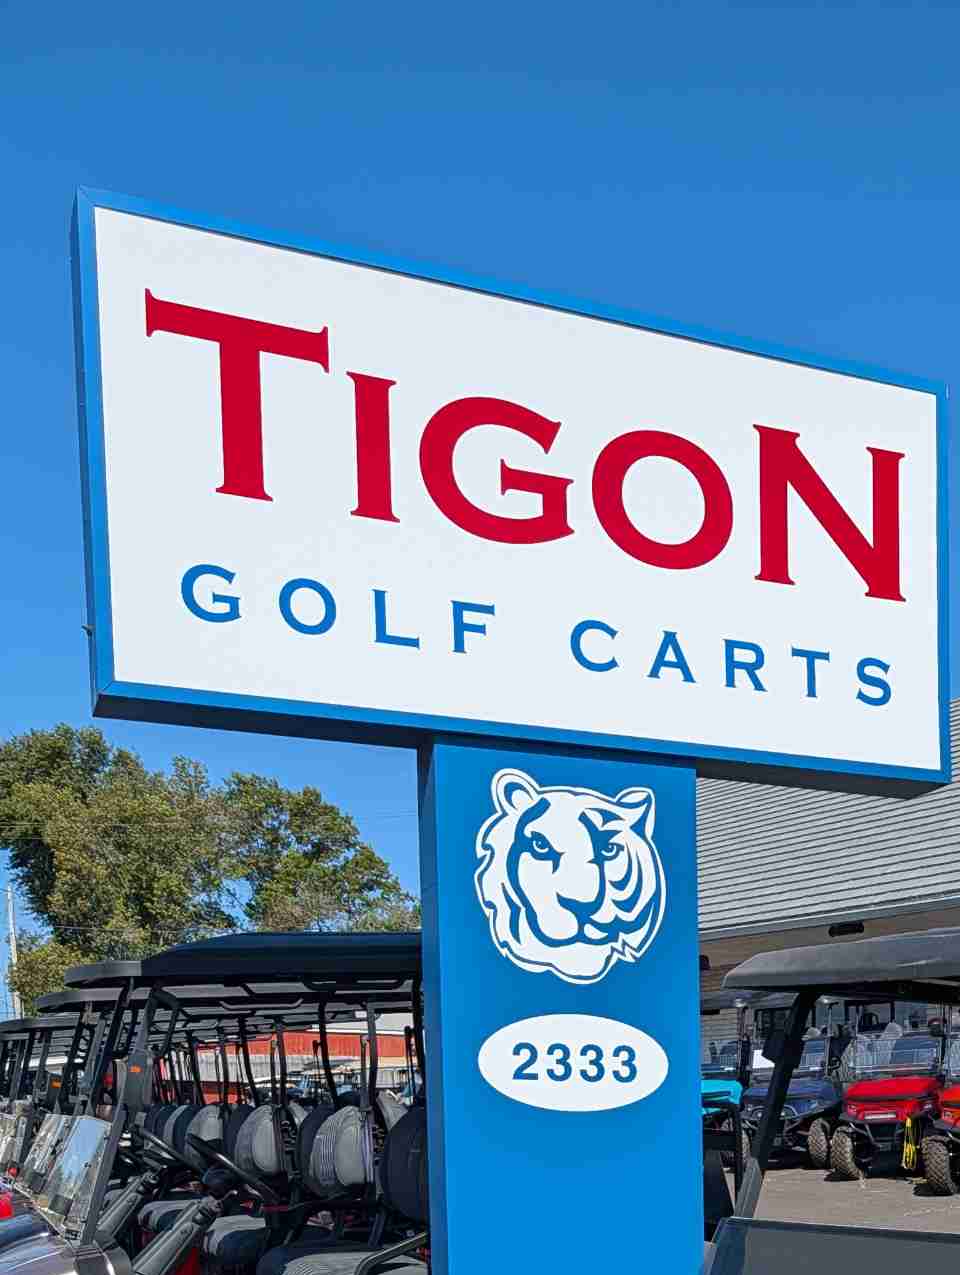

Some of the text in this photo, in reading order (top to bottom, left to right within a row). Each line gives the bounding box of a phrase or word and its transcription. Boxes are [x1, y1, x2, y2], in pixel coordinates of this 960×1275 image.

[144, 288, 906, 602] TIGON
[181, 564, 891, 706] GOLF CARTS
[513, 1043, 637, 1083] 2333
